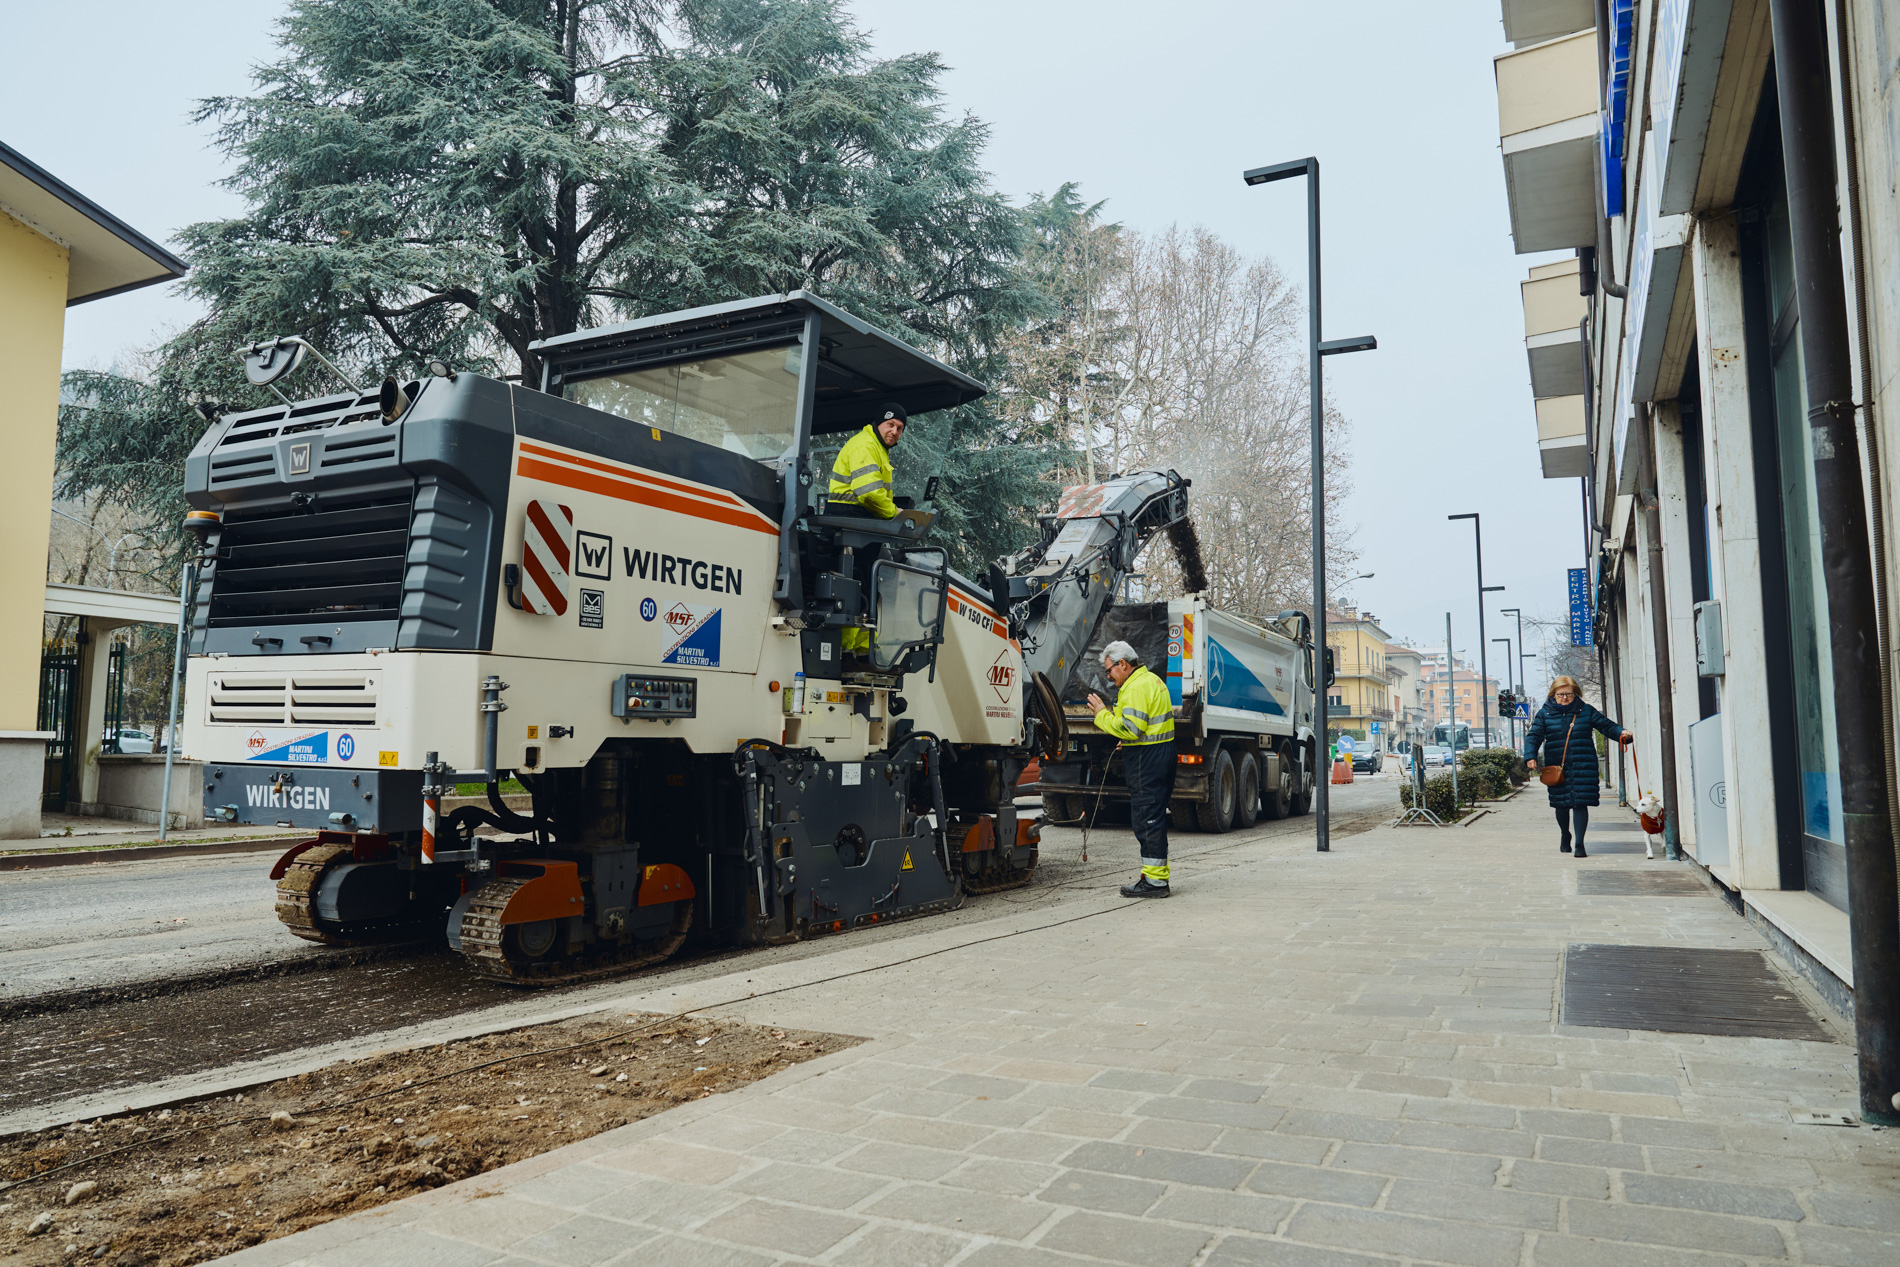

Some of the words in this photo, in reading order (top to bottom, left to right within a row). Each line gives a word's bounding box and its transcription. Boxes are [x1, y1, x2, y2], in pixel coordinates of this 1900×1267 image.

[581, 541, 607, 569] W
[623, 546, 742, 596] WIRTGEN
[1571, 571, 1580, 604] CENTRO
[642, 601, 655, 618] 60
[666, 611, 694, 626] MSF
[959, 602, 967, 617] W
[968, 608, 981, 625] 150
[981, 615, 994, 632] CFi
[1572, 611, 1581, 645] MARKET
[662, 626, 696, 659] COSTRUZIONI
[677, 646, 705, 657] MARTINI
[676, 655, 710, 666] SILVESTRO
[990, 664, 1015, 687] MSF
[248, 738, 266, 748] MSF
[263, 738, 294, 753] COSTRUZIONI
[289, 745, 313, 753] MARTINI
[340, 738, 352, 756] 60
[245, 784, 330, 811] WIRTGEN
